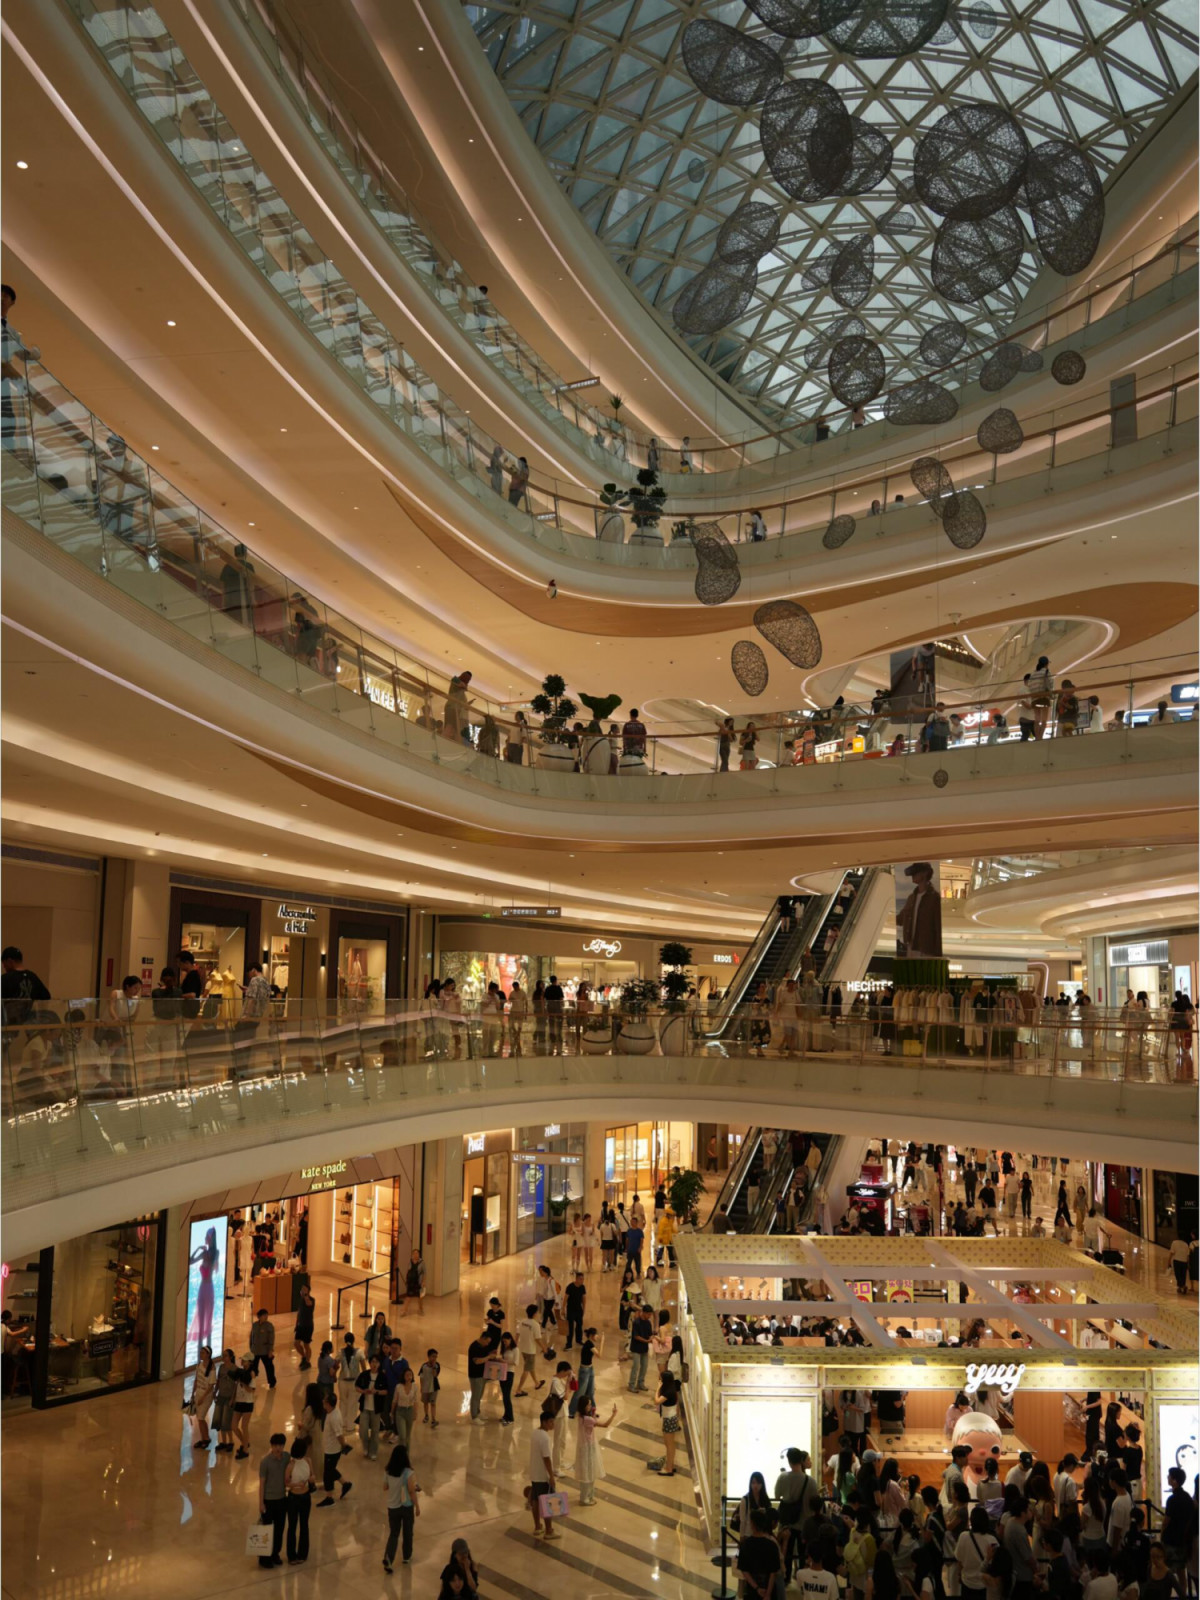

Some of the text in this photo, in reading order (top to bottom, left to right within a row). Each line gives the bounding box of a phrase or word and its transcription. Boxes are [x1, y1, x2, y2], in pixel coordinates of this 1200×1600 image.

[713, 955, 732, 963] ERDOS
[301, 1160, 347, 1179] kate spade
[311, 1180, 336, 1190] NEW YORK
[803, 1581, 828, 1594] WHAM!
